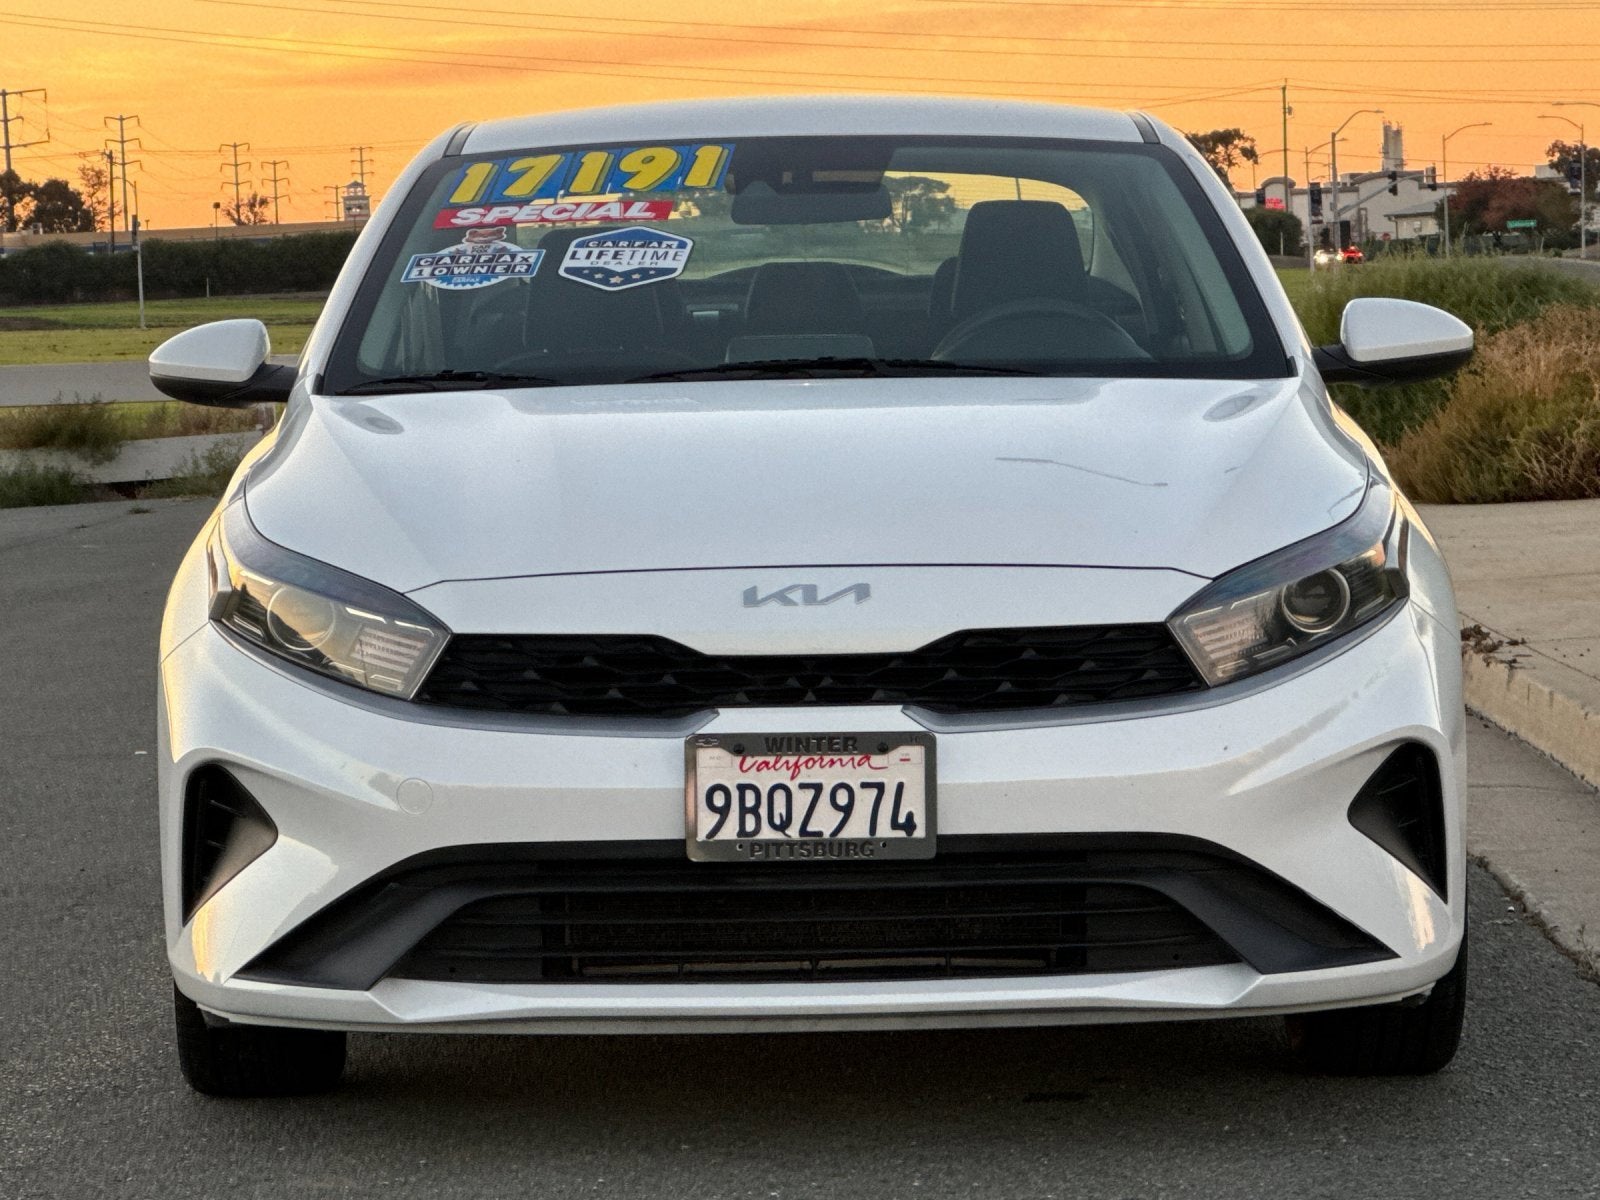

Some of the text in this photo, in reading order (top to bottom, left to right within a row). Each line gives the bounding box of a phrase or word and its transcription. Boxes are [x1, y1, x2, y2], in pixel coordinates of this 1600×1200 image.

[449, 145, 728, 203] 17191
[450, 201, 656, 225] SPECIAL
[588, 241, 675, 249] CARFAX
[419, 254, 533, 267] CARFAX
[569, 249, 685, 262] LIFETIME
[415, 263, 529, 277] 1 OWNER
[764, 736, 858, 753] WINTER
[738, 754, 888, 780] California
[705, 782, 917, 839] 9BQZ974
[750, 841, 874, 859] PITTSBURG
